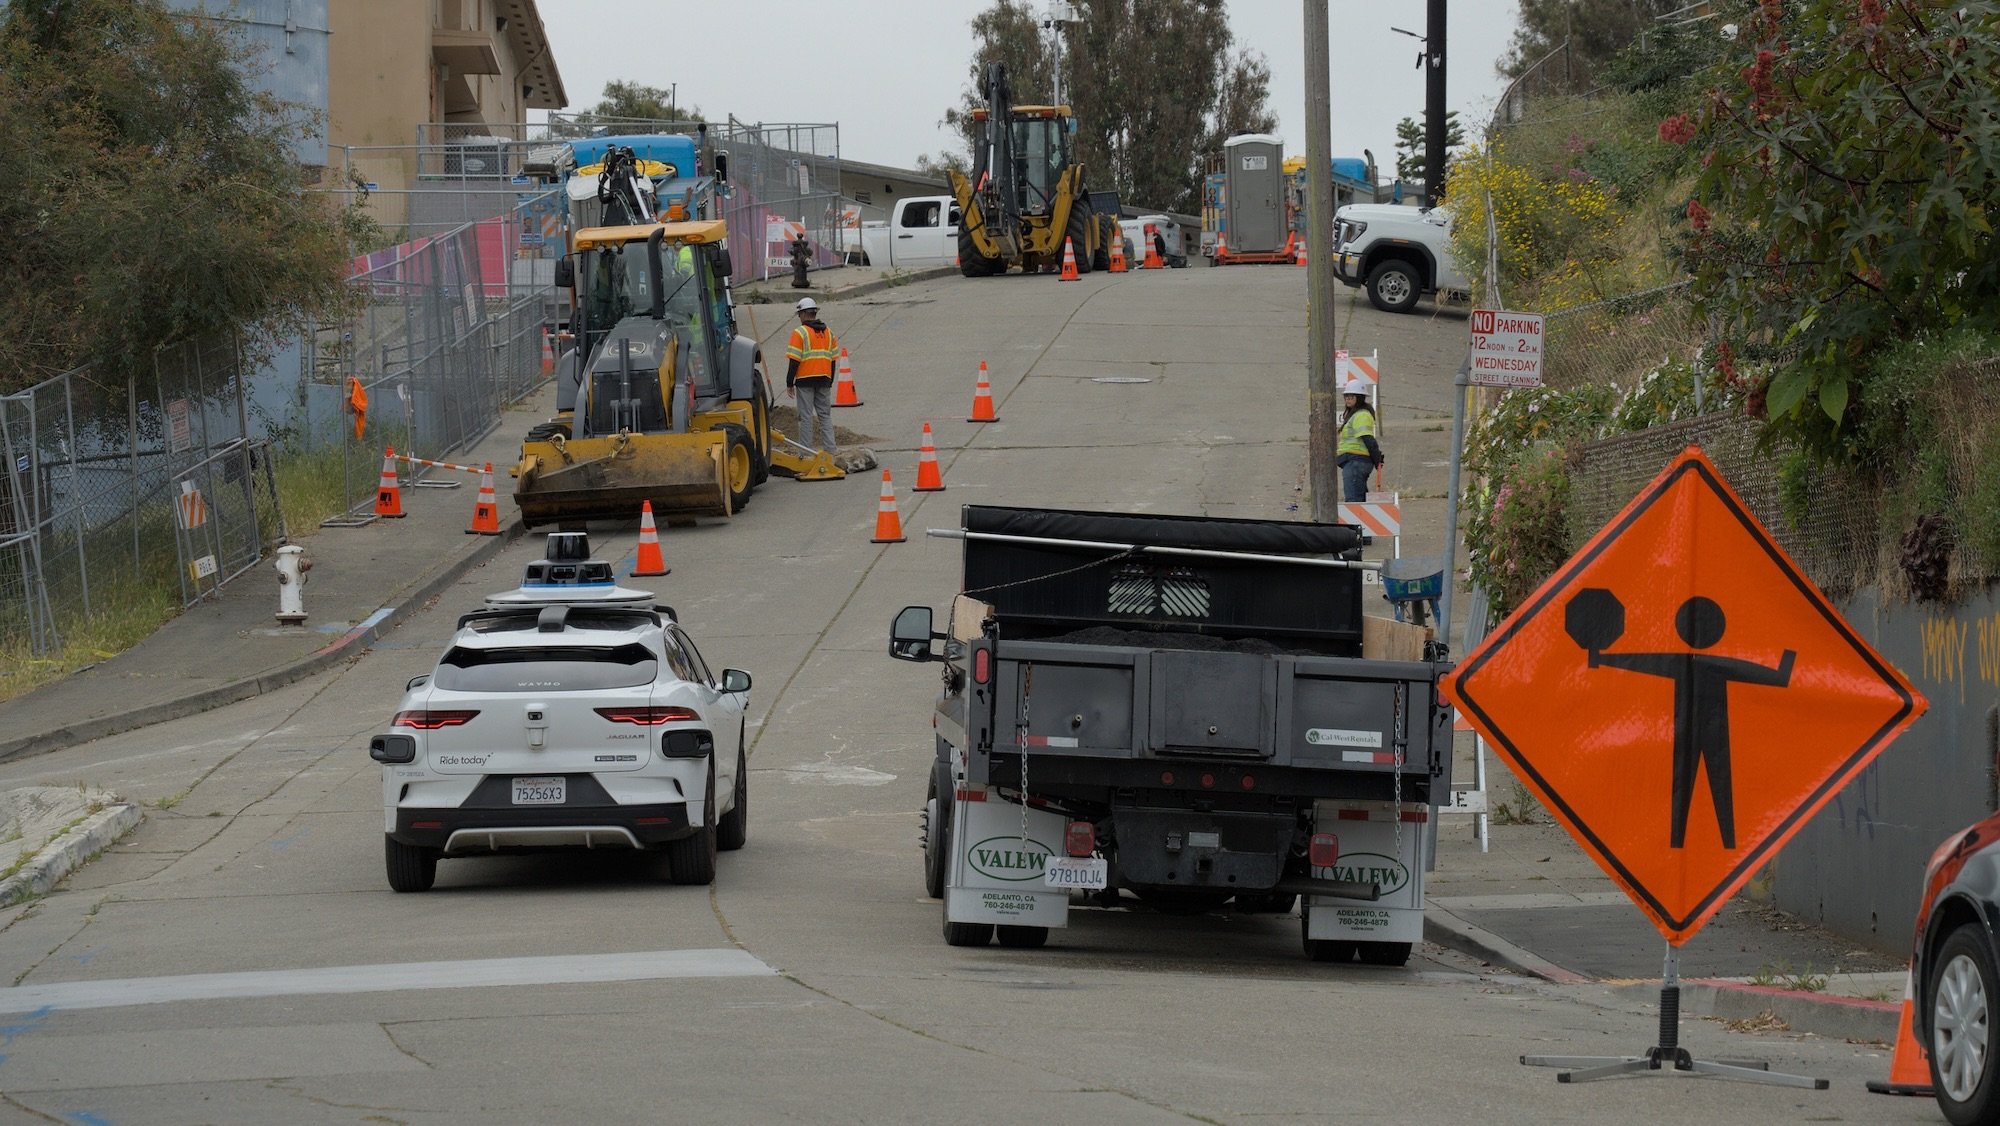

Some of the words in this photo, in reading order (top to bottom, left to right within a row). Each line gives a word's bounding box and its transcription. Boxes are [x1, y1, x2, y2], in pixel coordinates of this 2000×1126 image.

[1474, 313, 1492, 332] NO
[1497, 318, 1540, 335] PARKING
[1475, 356, 1538, 372] WEDNESDAY
[1474, 373, 1499, 382] STREET
[1503, 375, 1535, 384] CLEANING
[439, 756, 459, 765] Ride
[461, 756, 487, 767] today
[515, 787, 562, 801] 75256X3
[977, 849, 1048, 871] VALEW
[1050, 868, 1102, 884] 97810J4
[1331, 866, 1400, 886] VALEW
[982, 893, 1023, 902] ADELANTO,
[984, 901, 1034, 911] 760-246-4878
[1336, 909, 1377, 918] ADELANTO,
[1338, 918, 1389, 927] 760-246-4878
